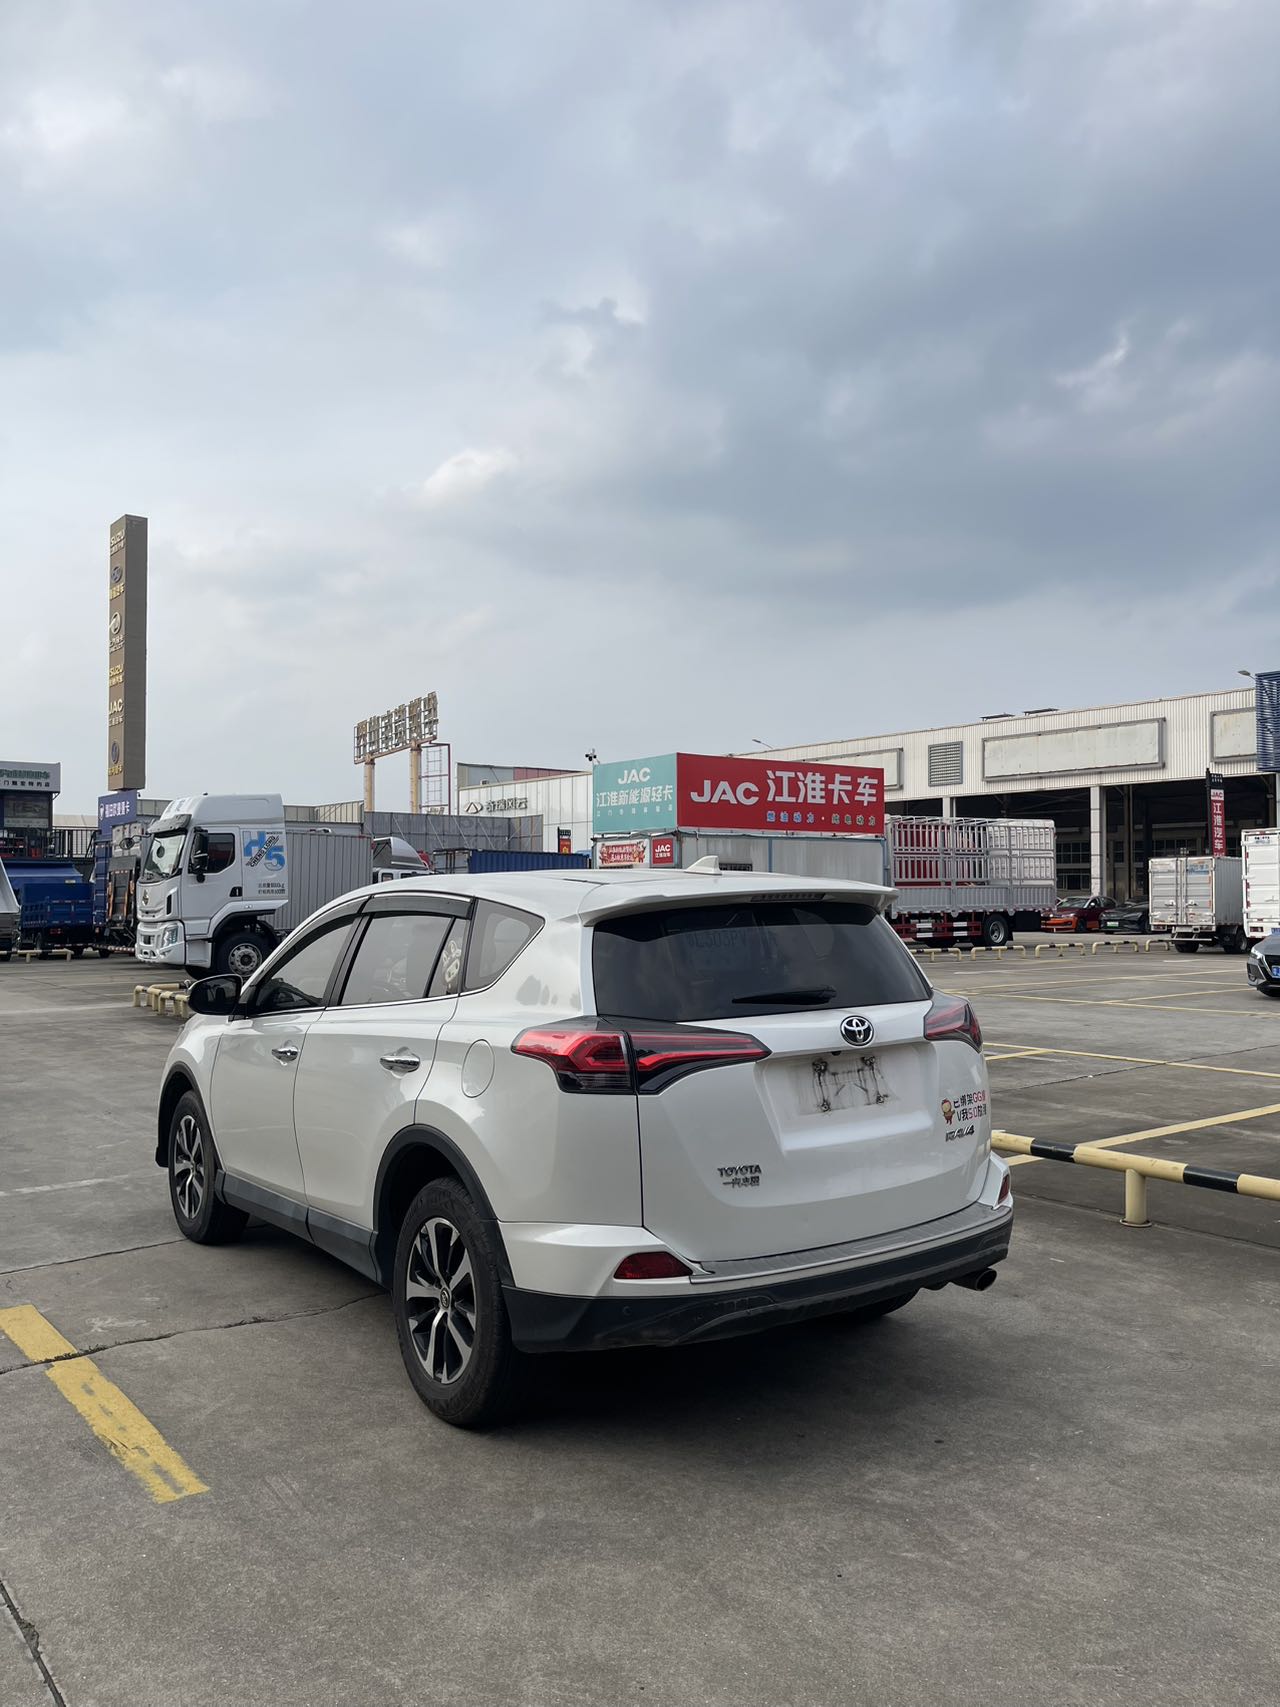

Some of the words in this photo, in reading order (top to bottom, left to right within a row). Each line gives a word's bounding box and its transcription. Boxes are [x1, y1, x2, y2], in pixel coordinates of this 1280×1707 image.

[618, 767, 651, 784] JAC
[596, 785, 674, 808] 江淮新能源轻卡
[690, 779, 760, 806] JAC
[766, 769, 879, 807] 江淮卡车
[1211, 791, 1223, 799] JAC
[1213, 802, 1223, 850] 江淮汽车
[655, 844, 671, 853] JAC
[717, 1164, 762, 1178] TOYOTA
